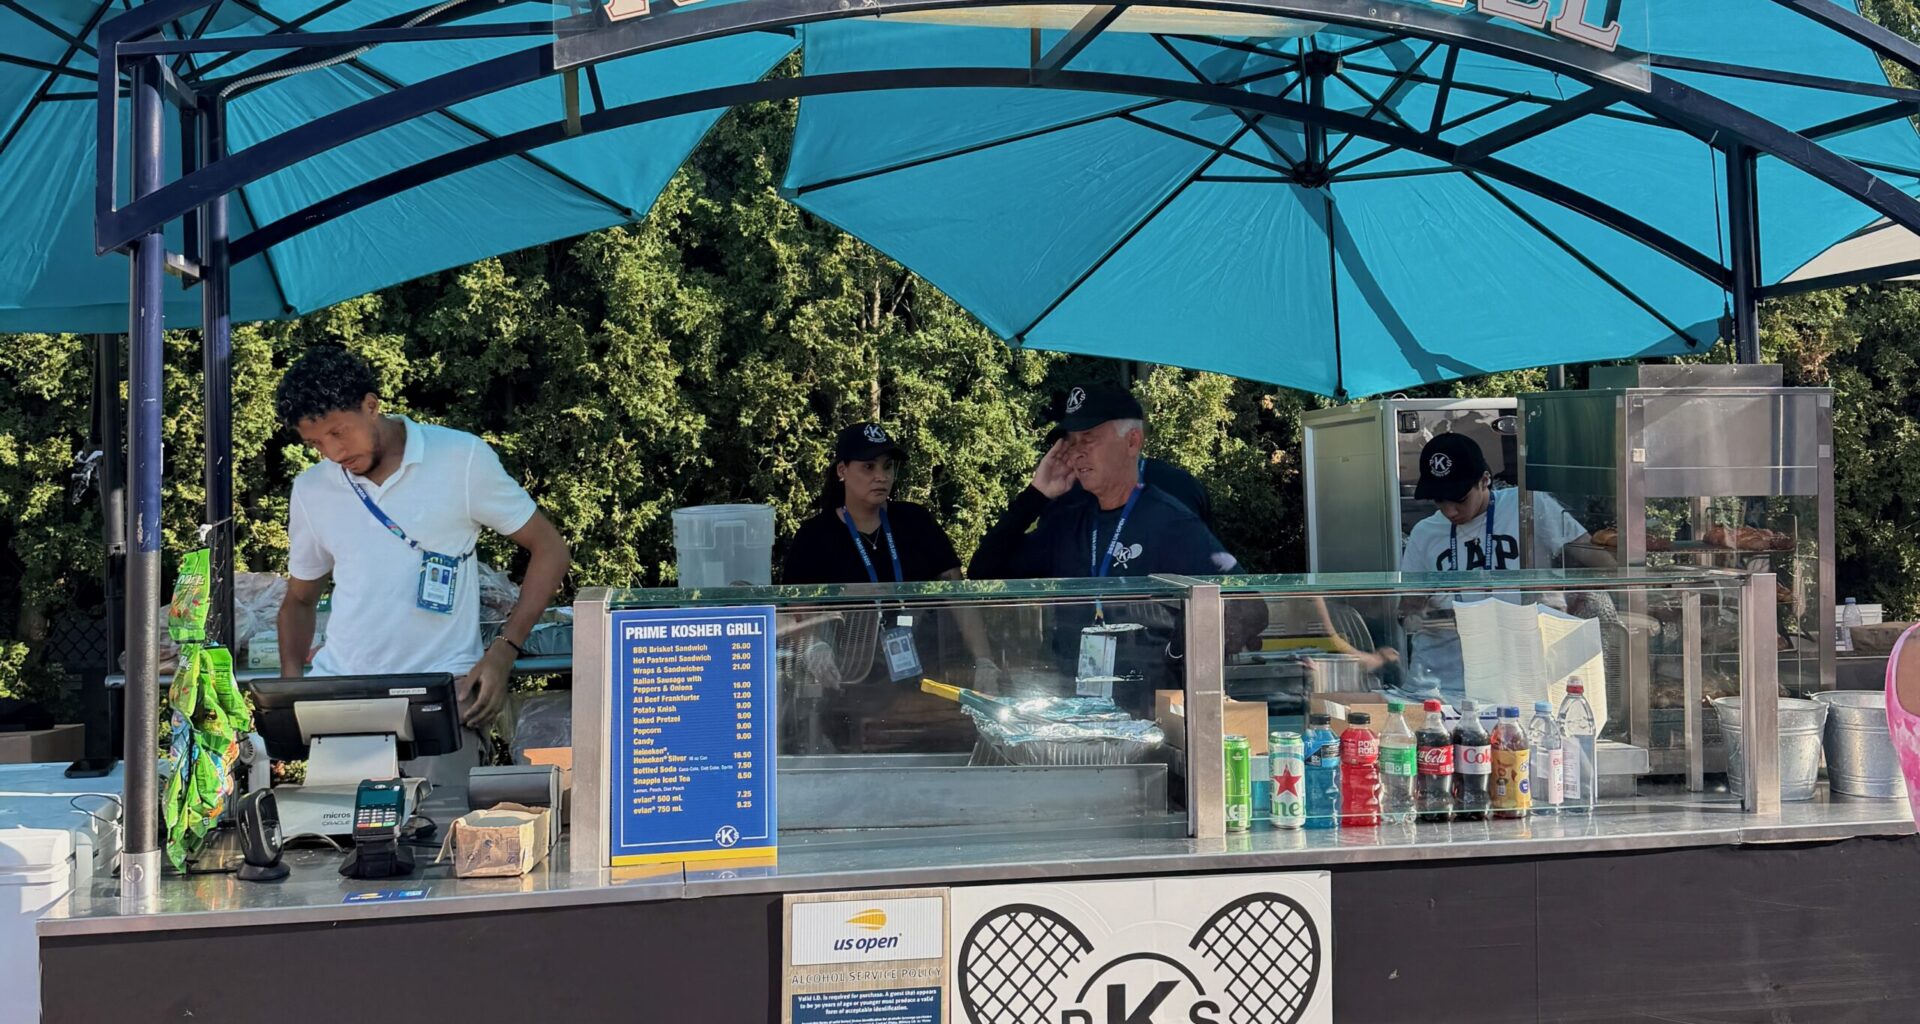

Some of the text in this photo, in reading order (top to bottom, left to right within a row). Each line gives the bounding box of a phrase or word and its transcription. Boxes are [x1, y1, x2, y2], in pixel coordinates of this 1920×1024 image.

[626, 622, 762, 640] PRIME KOSHER GRILL
[633, 644, 708, 654] BBQ Brisket Sandwich
[646, 655, 677, 663] Pastrami
[679, 654, 712, 662] Sandwich
[633, 667, 655, 675] Wraps
[663, 665, 704, 673] Sandwiches
[633, 677, 655, 685] Italian
[656, 676, 685, 684] Sausage
[633, 685, 661, 693] Peppers
[670, 684, 693, 692] Onions
[644, 695, 660, 703] Beef
[661, 694, 700, 702] Frankfurter
[657, 705, 677, 713] Knish
[656, 715, 681, 723] Pretzel
[633, 726, 662, 735] Popcorn
[633, 737, 655, 746] Candy
[660, 766, 677, 774] Soda
[633, 775, 691, 785] Snapple Iced Tea
[672, 794, 683, 802] mL
[737, 790, 752, 798] 7.25
[657, 805, 671, 813] 750
[672, 804, 683, 812] mL
[323, 811, 351, 819] micros
[833, 935, 899, 953] us open
[792, 967, 942, 985] ALCOHOL SERVICE POLICY
[828, 993, 850, 1001] required
[859, 991, 884, 1000] purchase.
[890, 990, 904, 998] guest
[916, 989, 937, 997] appears
[822, 1002, 836, 1010] years
[843, 1001, 853, 1009] age
[859, 1000, 881, 1009] younger
[895, 997, 916, 1006] produce
[845, 1006, 873, 1015] acceptable
[873, 1005, 909, 1013] identification.
